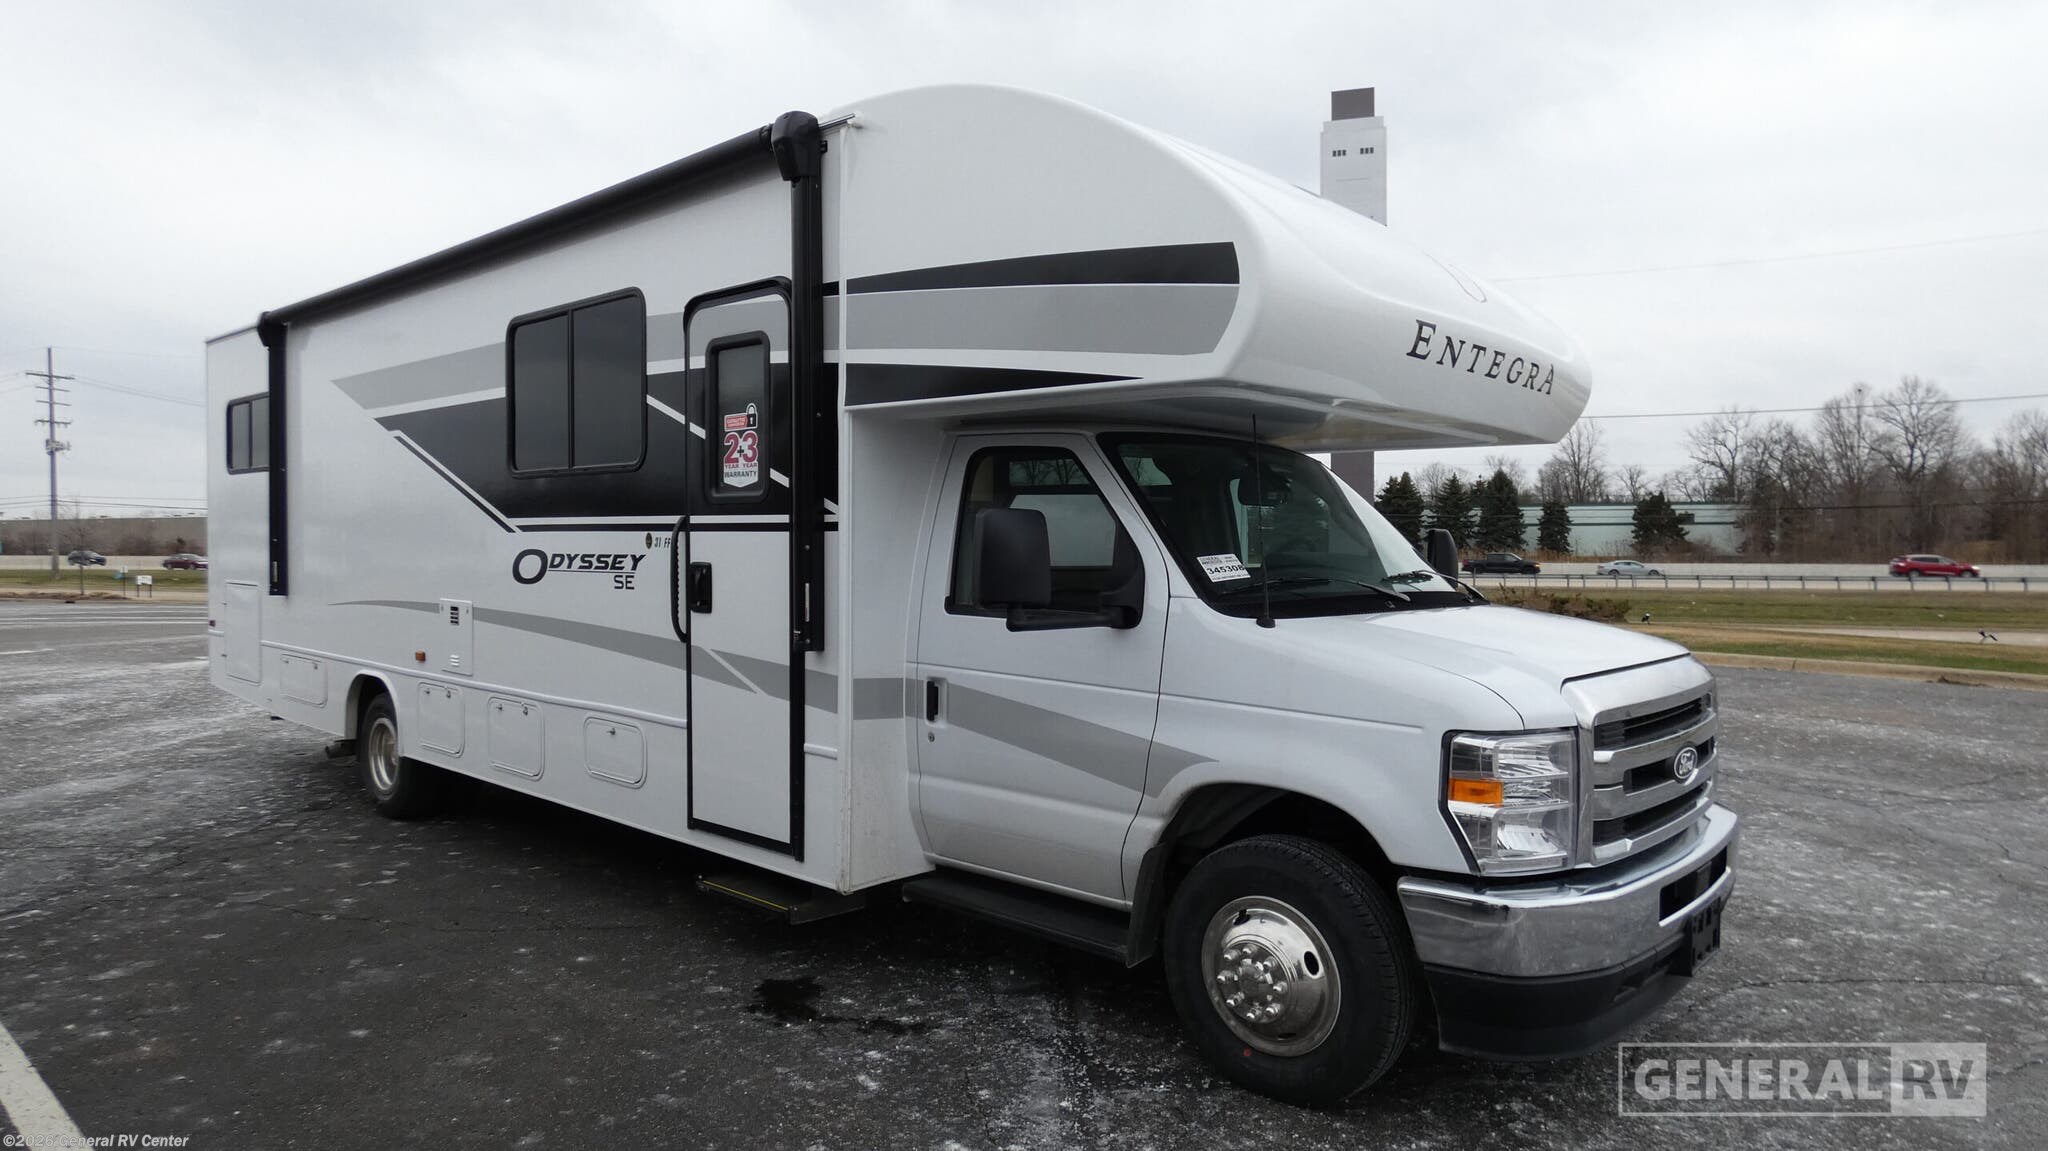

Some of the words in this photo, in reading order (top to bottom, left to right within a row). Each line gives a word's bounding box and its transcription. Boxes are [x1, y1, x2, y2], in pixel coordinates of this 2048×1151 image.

[1406, 319, 1555, 395] ENTEGRA
[725, 470, 757, 478] WARRANTY
[512, 549, 646, 585] ODYSSEY
[614, 575, 635, 590] SE
